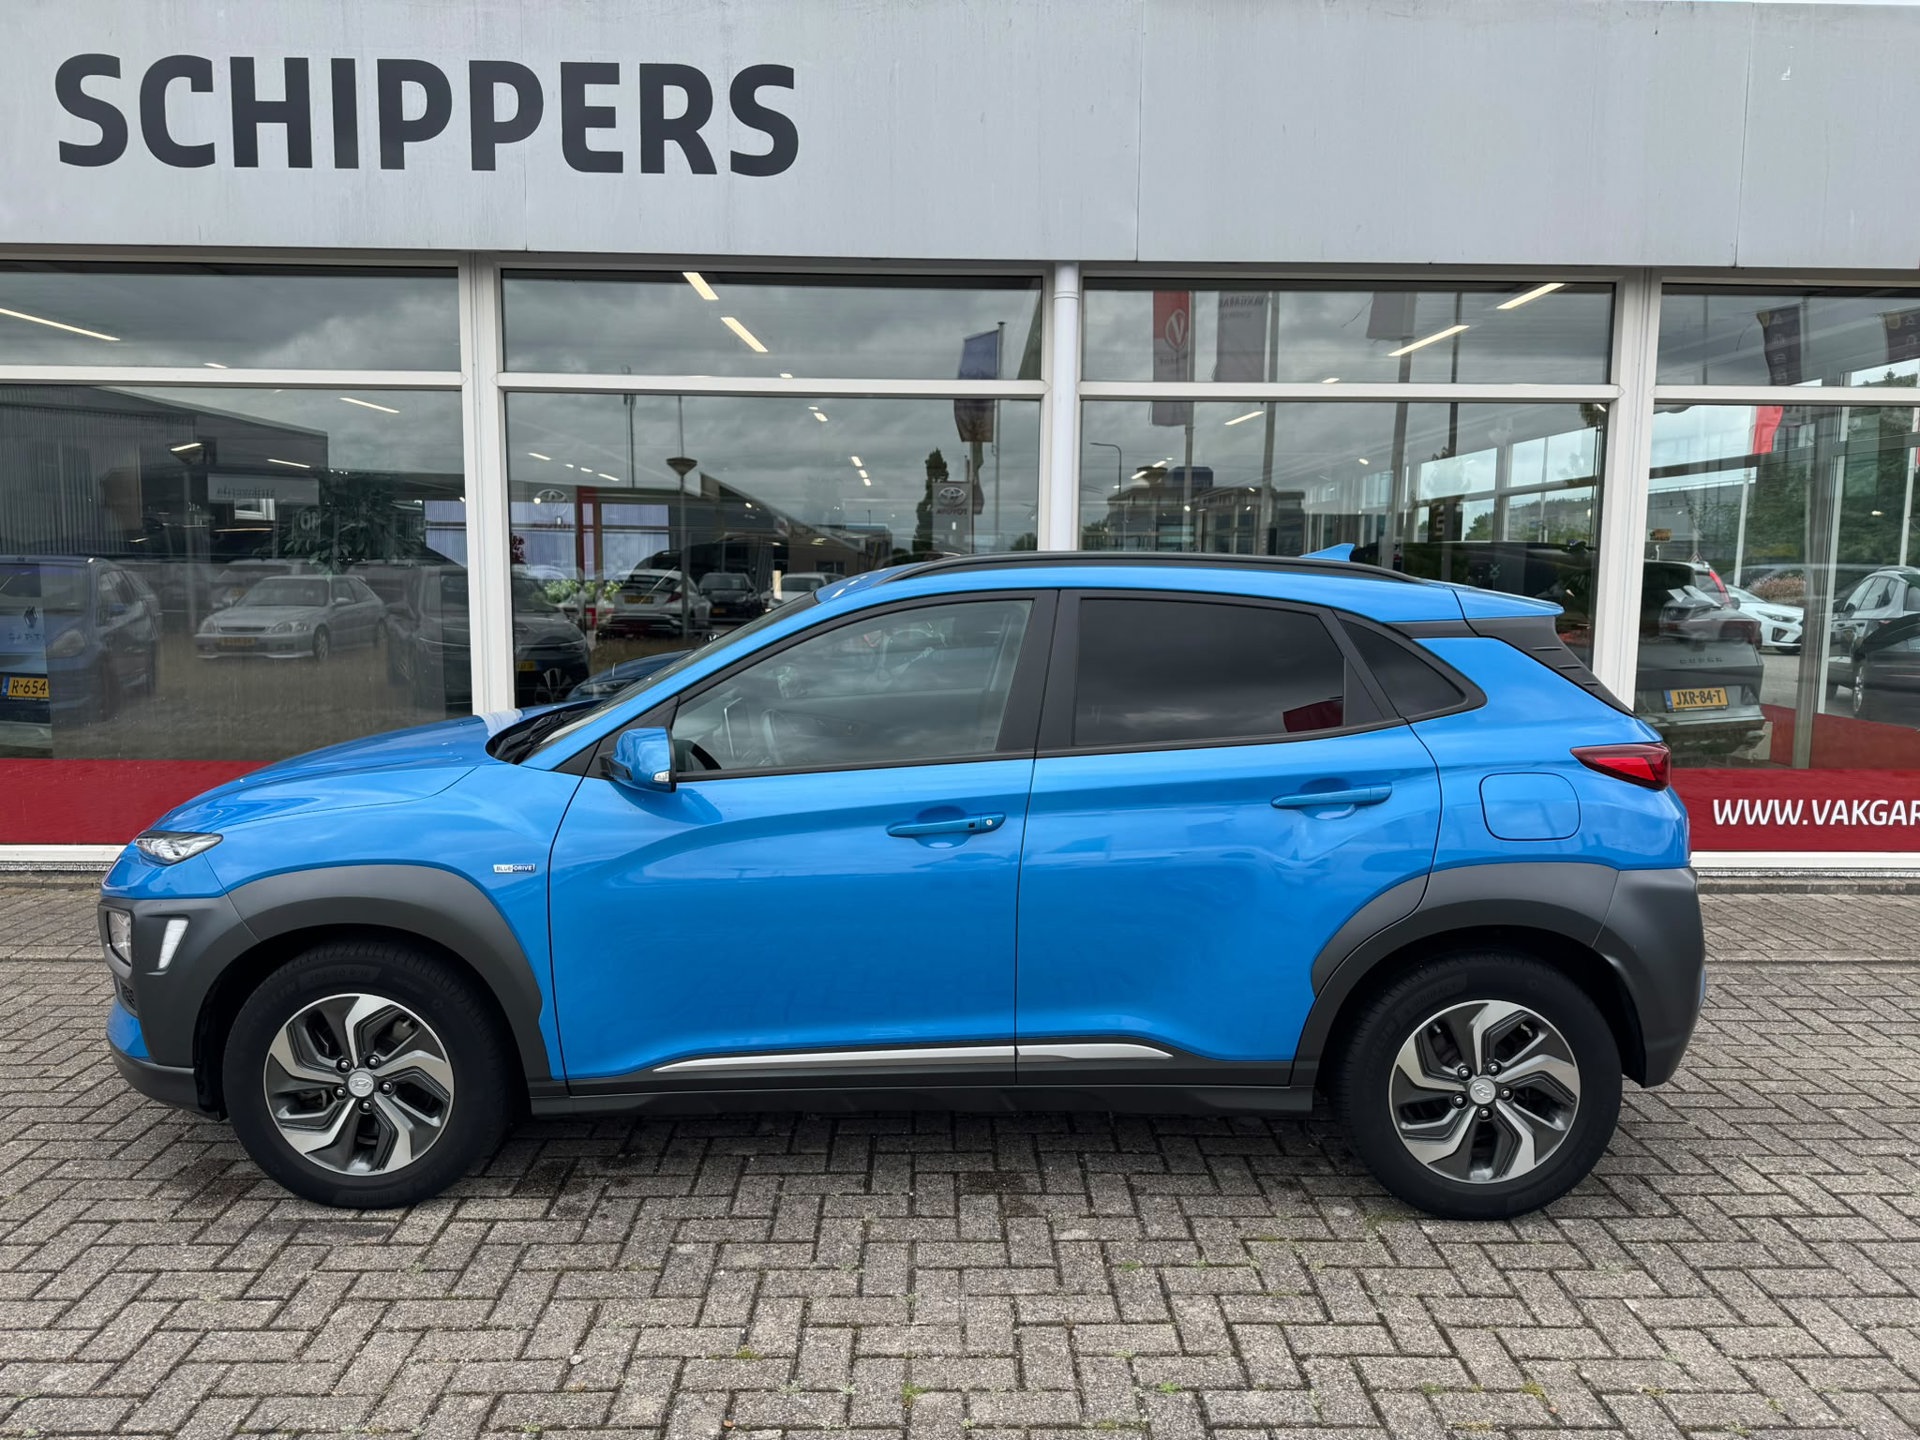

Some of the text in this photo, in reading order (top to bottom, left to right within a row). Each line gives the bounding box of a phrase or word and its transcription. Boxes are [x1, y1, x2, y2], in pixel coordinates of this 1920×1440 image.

[55, 53, 800, 177] SCHIPPERS
[1676, 692, 1722, 705] JXR-84-T
[1713, 799, 1920, 826] WWW.VAKGAR
